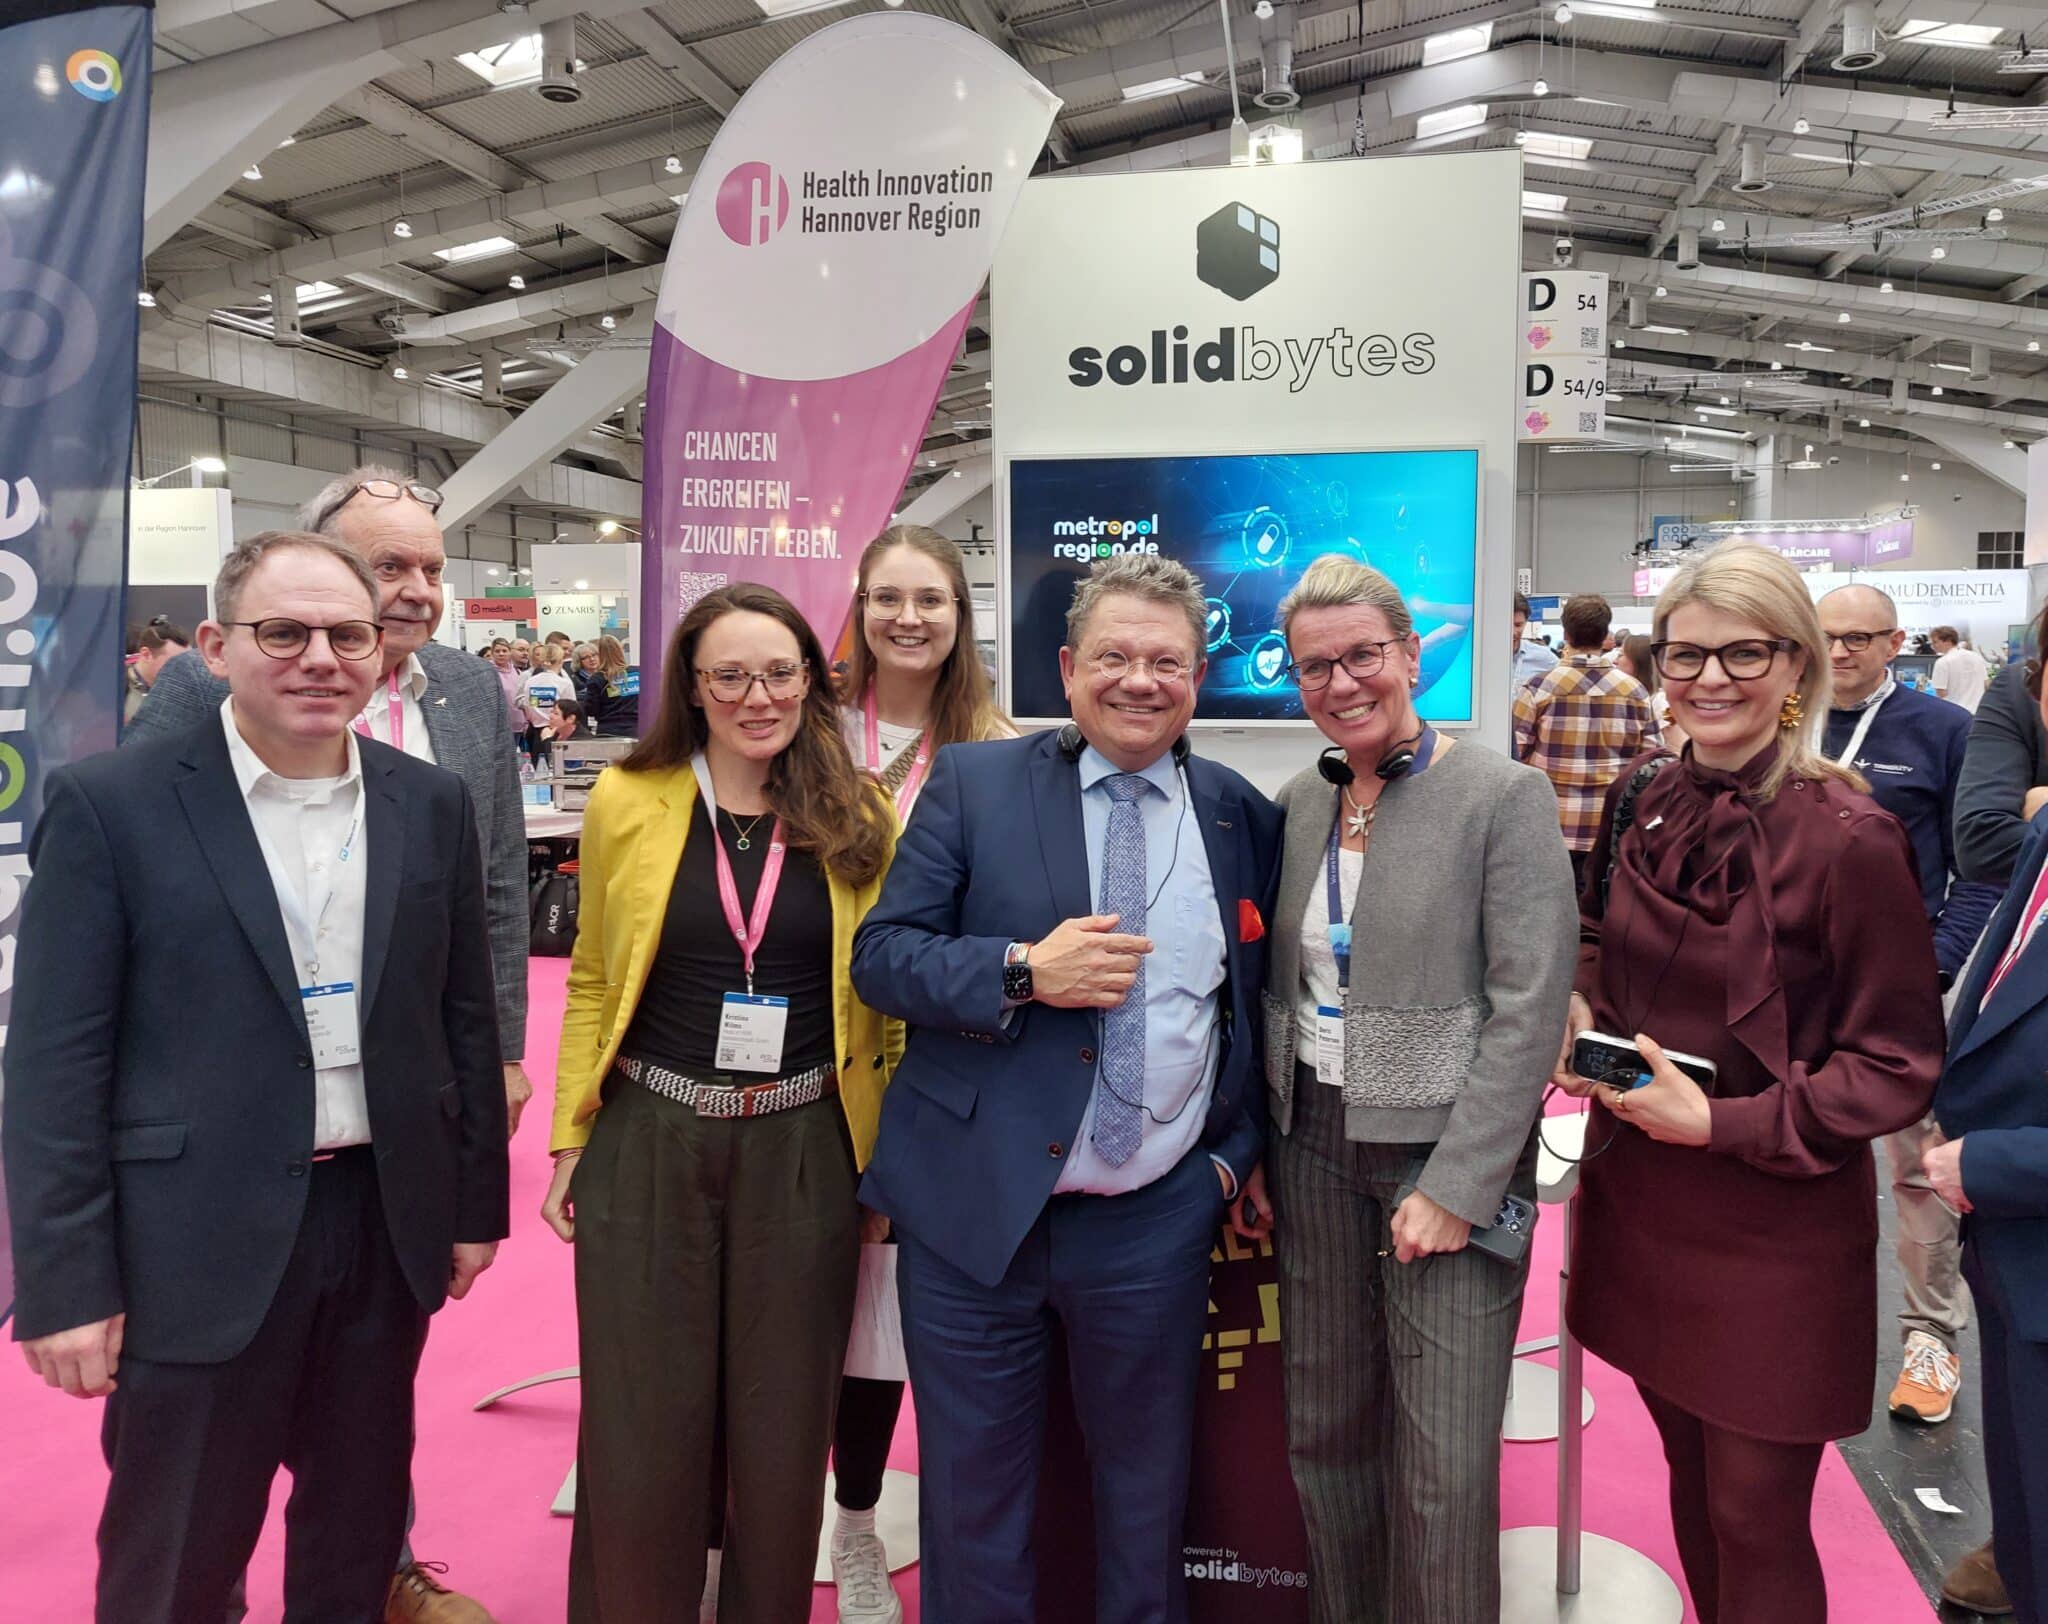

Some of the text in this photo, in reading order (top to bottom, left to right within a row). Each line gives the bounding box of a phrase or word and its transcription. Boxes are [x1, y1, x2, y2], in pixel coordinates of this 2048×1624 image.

[803, 165, 993, 198] Health Innovation
[802, 201, 981, 237] Hannover Region
[1528, 278, 1597, 311] D 54
[1068, 324, 1435, 393] solidbytes
[1526, 364, 1605, 399] D 54/9
[684, 431, 777, 461] CHANCEN
[682, 478, 790, 510] ERGREIFEN
[679, 525, 842, 559] ZUKUNFT LEBEN.
[1053, 513, 1159, 541] metropol
[1053, 537, 1159, 563] region.de
[482, 604, 513, 613] medikit
[555, 605, 595, 614] ZENARIS
[1226, 1548, 1238, 1560] by
